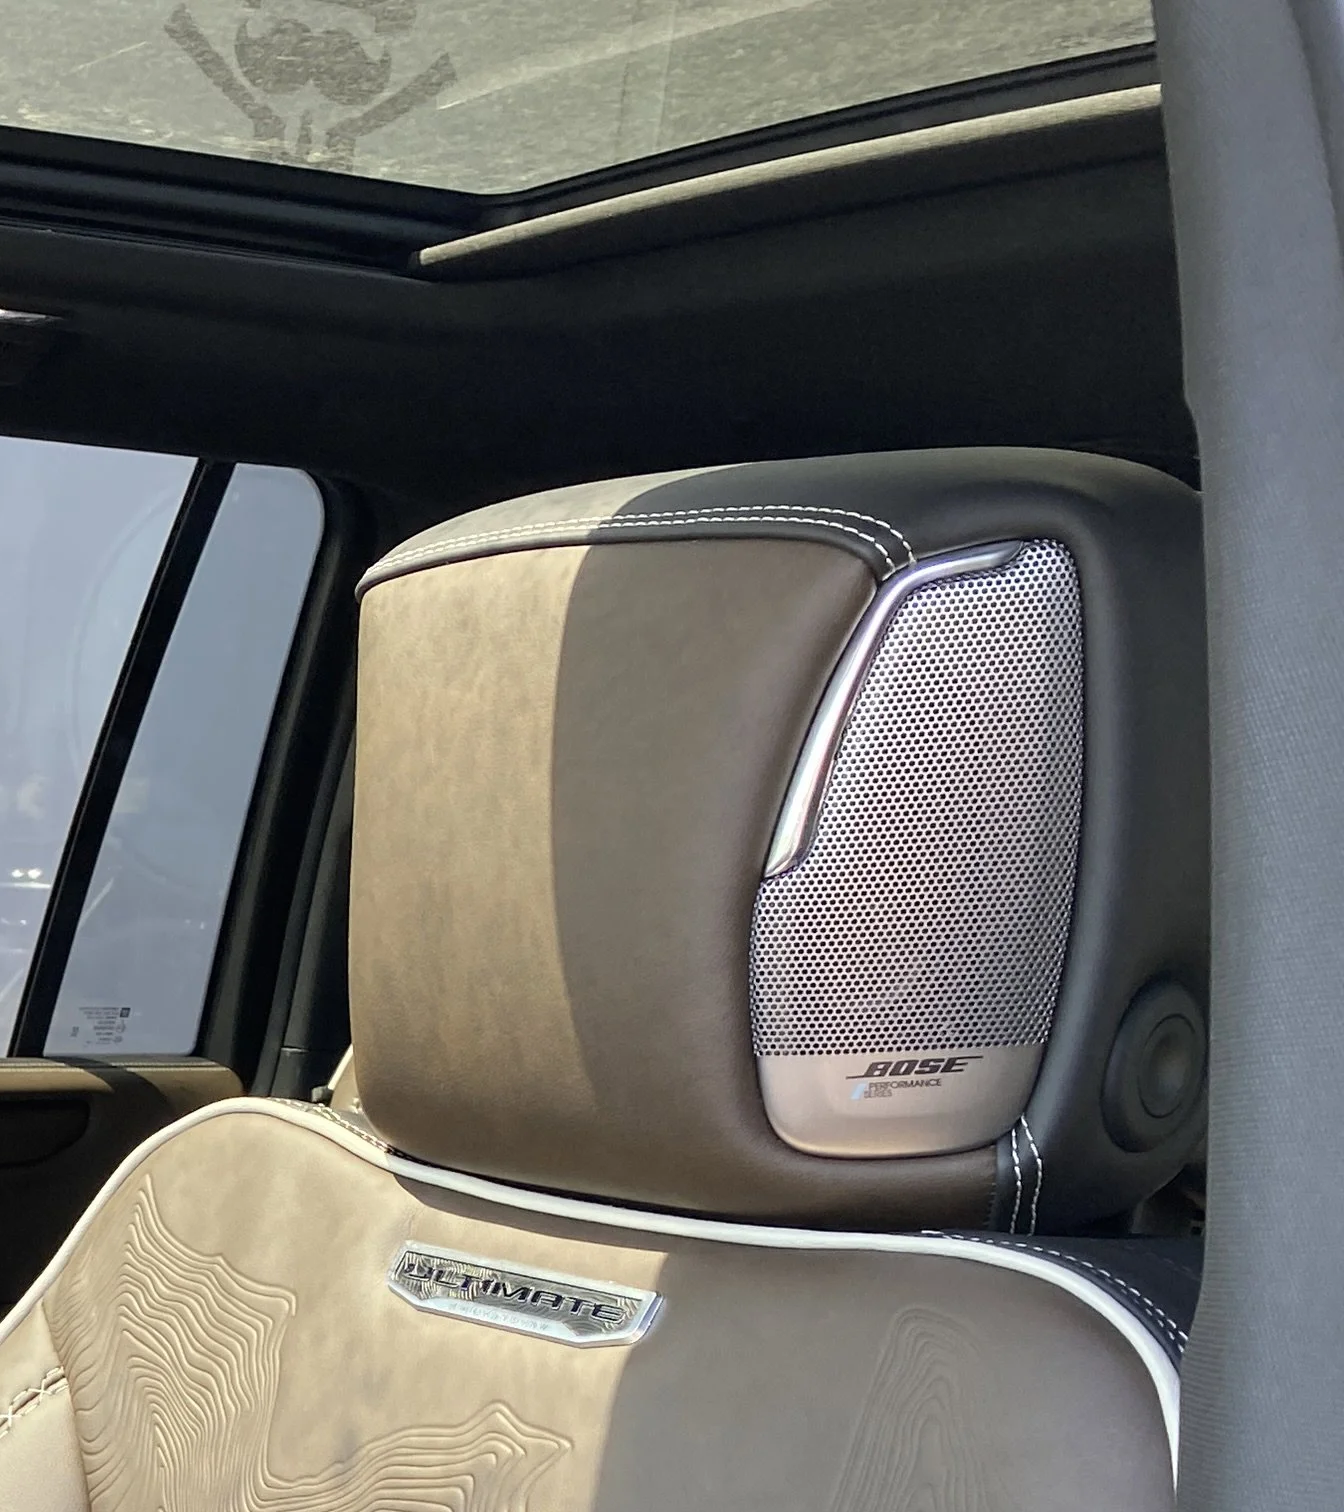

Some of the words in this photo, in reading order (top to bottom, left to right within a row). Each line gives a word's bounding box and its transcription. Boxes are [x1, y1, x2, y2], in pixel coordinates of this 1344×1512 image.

[845, 1056, 984, 1080] BOSE
[869, 1078, 942, 1091] PERFORMANCE
[404, 1262, 625, 1324] ULTIMATE
